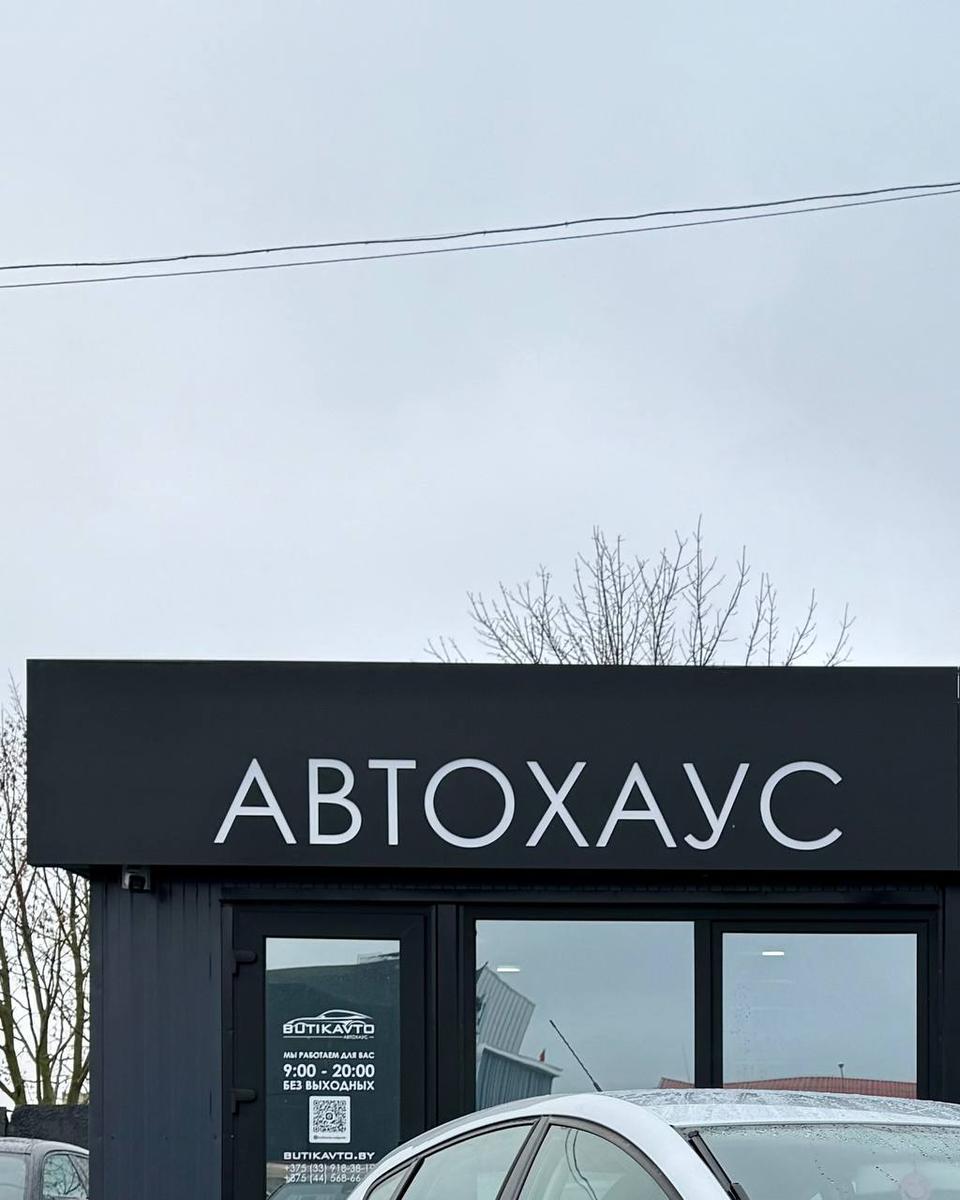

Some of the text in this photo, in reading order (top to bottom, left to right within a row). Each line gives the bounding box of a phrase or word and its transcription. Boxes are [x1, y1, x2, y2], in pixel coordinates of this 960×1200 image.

[213, 757, 844, 851] АВТОХАУС
[282, 1023, 375, 1034] BUTIKAVTO
[283, 1051, 375, 1060] МЫ РАБОТАЕМ ДЛЯ ВАС
[283, 1063, 317, 1078] 9:00
[332, 1063, 375, 1078] 20:00
[283, 1080, 375, 1092] БЕЗ ВЫХОДНЫХ
[283, 1151, 376, 1161] BUTIKAVTO.BY
